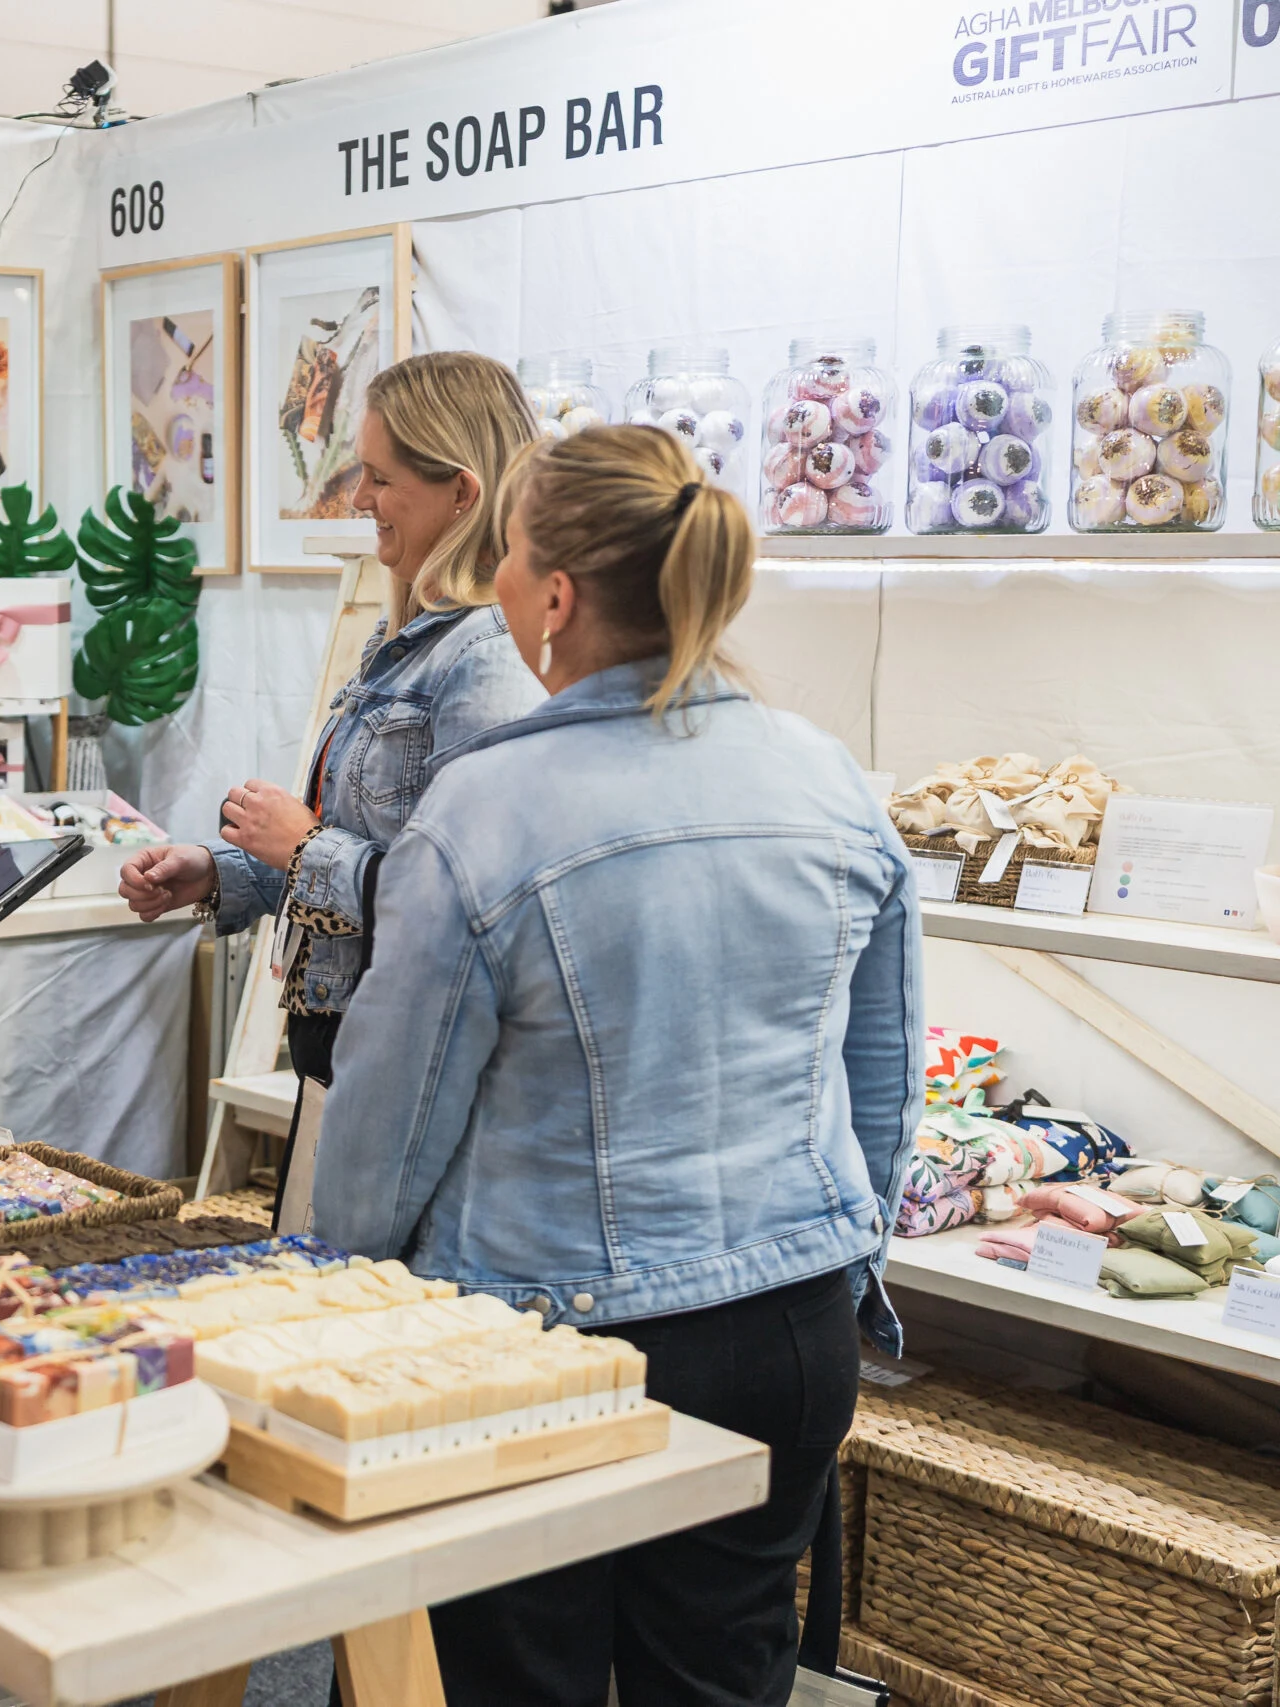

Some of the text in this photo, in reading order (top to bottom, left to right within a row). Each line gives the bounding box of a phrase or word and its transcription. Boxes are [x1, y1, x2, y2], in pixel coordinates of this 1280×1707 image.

[954, 6, 1022, 39] AGHA
[951, 56, 1198, 104] AUSTRALIAN GIFT & HOMEWARES ASSOCIATION
[338, 85, 663, 196] THE SOAP BAR
[110, 181, 164, 237] 608
